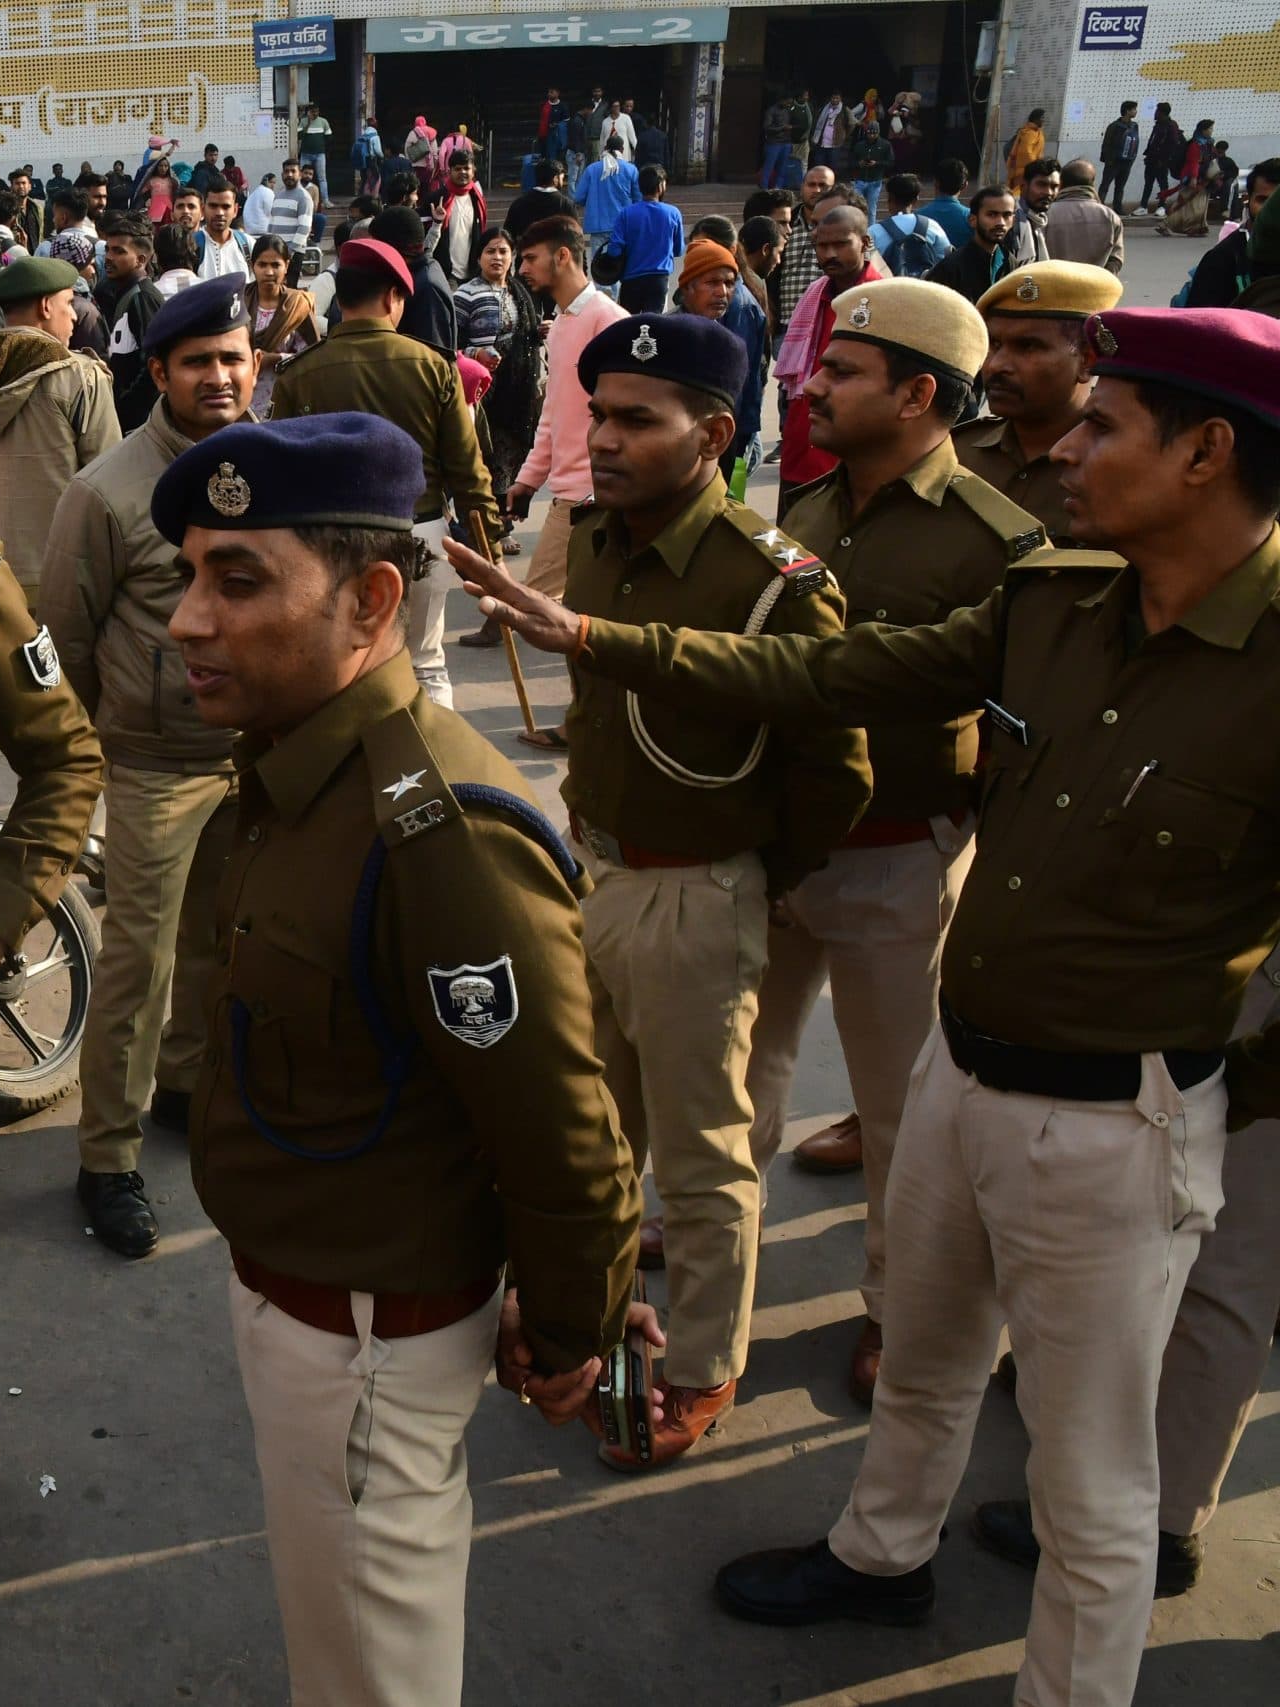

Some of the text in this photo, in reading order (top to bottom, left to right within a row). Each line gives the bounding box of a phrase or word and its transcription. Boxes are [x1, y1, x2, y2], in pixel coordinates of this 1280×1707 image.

[400, 20, 511, 47] गेट
[1087, 11, 1143, 32] टिकट घर
[259, 24, 328, 49] पड़ाव वर्जित
